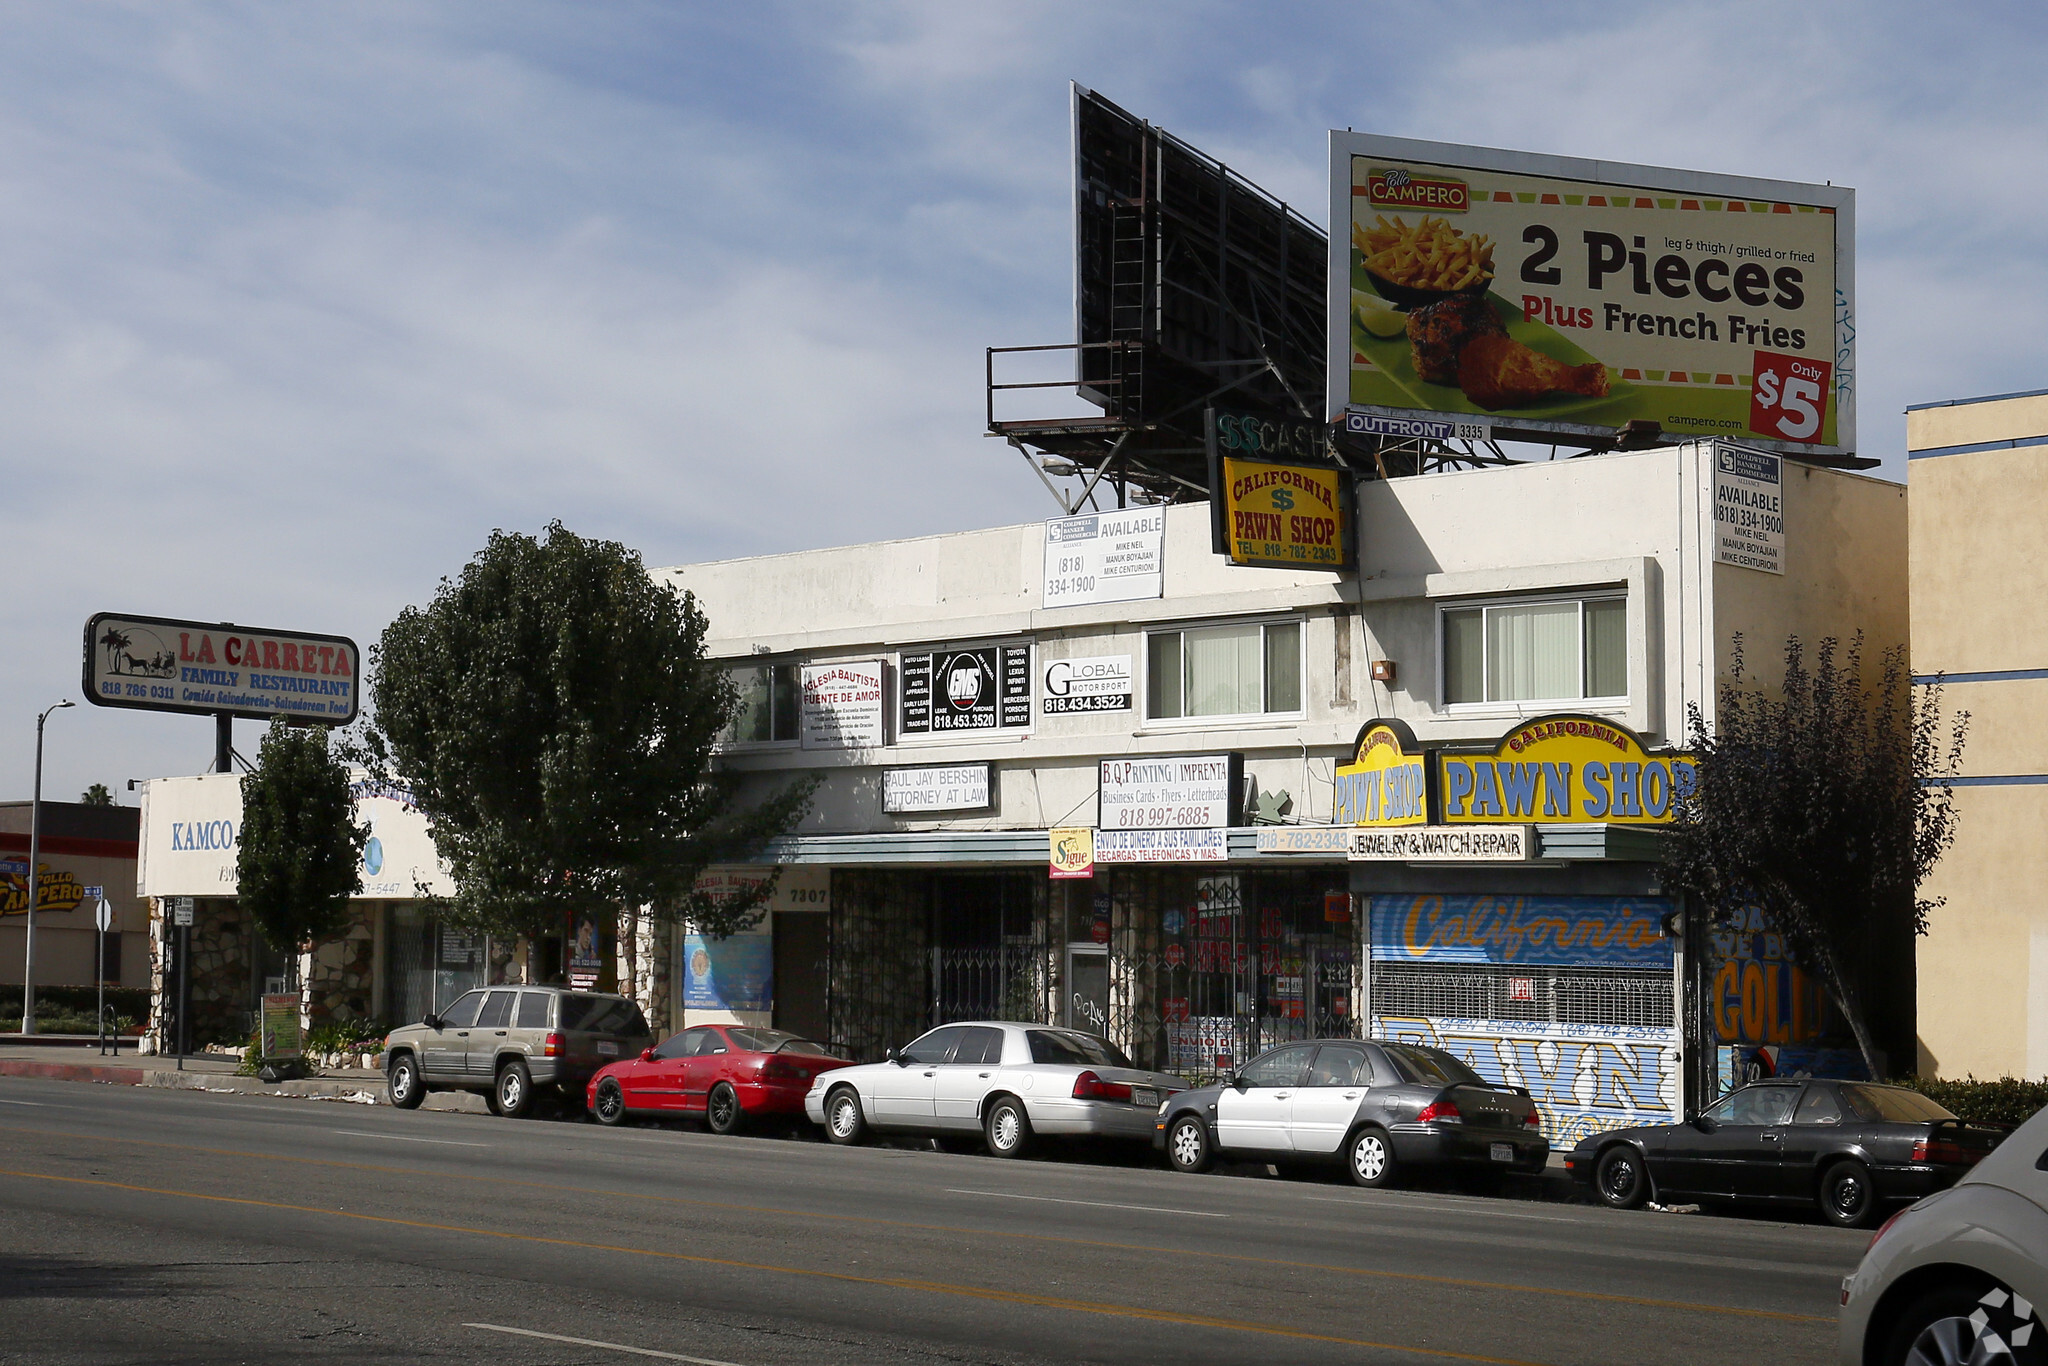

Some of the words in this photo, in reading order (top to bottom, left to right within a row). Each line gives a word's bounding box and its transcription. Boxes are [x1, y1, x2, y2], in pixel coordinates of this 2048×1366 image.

[1384, 170, 1410, 187] Pollo
[1372, 183, 1465, 205] CAMPERO
[1664, 237, 1682, 251] leg
[1685, 239, 1693, 250] &
[1696, 240, 1726, 256] thigh
[1736, 244, 1772, 260] grilled
[1774, 250, 1787, 260] or
[1789, 248, 1815, 263] fried
[1520, 225, 1562, 286] 2
[1583, 230, 1805, 310] Pieces
[1522, 295, 1593, 329] Plus
[1604, 303, 1718, 341] French
[1728, 315, 1806, 349] Fries
[1791, 362, 1822, 381] Only
[1755, 369, 1820, 439] $5
[1459, 424, 1483, 439] 3335
[1668, 415, 1742, 430] campero.com
[1737, 451, 1771, 466] COLDWELL
[1737, 460, 1762, 471] BANKER
[1737, 467, 1777, 481] COMMERCIAL
[1233, 470, 1333, 512] CALIFORNIA
[1718, 485, 1779, 513] AVAILABLE
[1063, 519, 1092, 527] COLDWELL
[1101, 517, 1161, 538] AVAILABLE
[1234, 511, 1282, 542] PAWN
[1291, 515, 1335, 545] SHOP
[1716, 503, 1739, 525] (818)
[1740, 509, 1781, 534] 334-1900
[1063, 526, 1085, 534] BANKER
[1063, 531, 1097, 540] COMMERCIAL
[1734, 526, 1752, 538] MIKE
[1753, 531, 1769, 542] NEIL
[1116, 541, 1131, 551] MIKE
[1131, 541, 1144, 549] NEIL
[1237, 540, 1259, 556] TEL.
[1722, 537, 1745, 551] MANUK
[1747, 543, 1778, 558] BOYAJIAN
[1058, 555, 1084, 576] (818)
[1106, 553, 1126, 564] MANUK
[1126, 551, 1154, 562] BOYAJIAN
[1721, 551, 1738, 563] MIKE
[1739, 555, 1778, 571] CENTURIONI
[1104, 566, 1118, 576] MIKE
[1119, 563, 1154, 574] CENTURIONI
[1048, 575, 1095, 596] 334-1900
[179, 632, 217, 664] LA
[224, 636, 352, 677] CARRETA
[1006, 648, 1026, 656] TOYOTA
[1007, 658, 1026, 666] HONDA
[803, 670, 837, 693] IGLESIA
[838, 669, 880, 689] BAUTISTA
[935, 670, 943, 681] ANY
[1008, 668, 1025, 676] LEXUS
[1045, 662, 1127, 696] GLOBAL
[101, 681, 121, 695] 818
[125, 682, 147, 697] 786
[151, 684, 174, 700] 0311
[180, 667, 239, 688] FAMILY
[250, 674, 351, 697] RESTAURANT
[906, 687, 929, 696] APPRAISAL
[949, 668, 980, 697] GMS
[1010, 686, 1023, 694] BMW
[182, 687, 217, 703] Comida
[328, 701, 349, 714] Food
[803, 693, 838, 705] FUENTE
[841, 692, 852, 702] DE
[855, 690, 880, 702] AMOR
[1003, 696, 1030, 704] MERCEDES
[1045, 695, 1126, 713] 818.434.3522
[909, 708, 926, 716] RETURN
[1004, 705, 1028, 714] PORSCHE
[1005, 714, 1028, 723] BENTLEY
[907, 720, 929, 728] TRADE-INS
[934, 714, 994, 728] 818.453.3520
[1508, 720, 1627, 751] CALIFORNIA
[1360, 731, 1398, 763] CALIFORNIA
[885, 772, 912, 788] PAUL
[916, 772, 934, 786] JAY
[940, 768, 987, 785] BERSHIN
[1180, 762, 1227, 782] IMPRENTA
[887, 790, 942, 806] ATTORNEY
[946, 789, 959, 803] AT
[964, 788, 987, 803] LAW
[1103, 790, 1134, 804] Business
[1135, 788, 1156, 802] Cards
[1161, 788, 1182, 806] Flyers
[1187, 786, 1228, 802] Letterheads
[1334, 769, 1381, 825] PAWN
[1384, 763, 1424, 819] SHOP
[1446, 761, 1573, 816] PAWN
[1582, 760, 1698, 818] SHOP
[1119, 808, 1144, 827] 818
[1148, 806, 1210, 826] 997-6885
[172, 820, 234, 850] KAMCO
[1096, 832, 1118, 850] ENVIO
[1119, 832, 1128, 849] DE
[1130, 832, 1156, 849] DINERO
[1157, 832, 1162, 848] A
[1164, 831, 1178, 848] SUS
[1180, 830, 1222, 848] FAMILIARES
[1350, 832, 1408, 855] JEWELRY
[1408, 833, 1421, 855] &
[1422, 832, 1470, 854] WATCH
[1474, 833, 1521, 855] REPAIR
[1056, 840, 1088, 868] Sigue
[1096, 850, 1137, 862] RECARGAS
[1140, 850, 1190, 861] TELEFONICAS
[1192, 850, 1198, 860] Y
[16, 864, 24, 872] St
[790, 890, 826, 903] 7307
[1404, 896, 1668, 960] California
[1712, 932, 1753, 960] WE
[1713, 959, 1825, 1044] GOLD
[1439, 1018, 1479, 1031] OPEN
